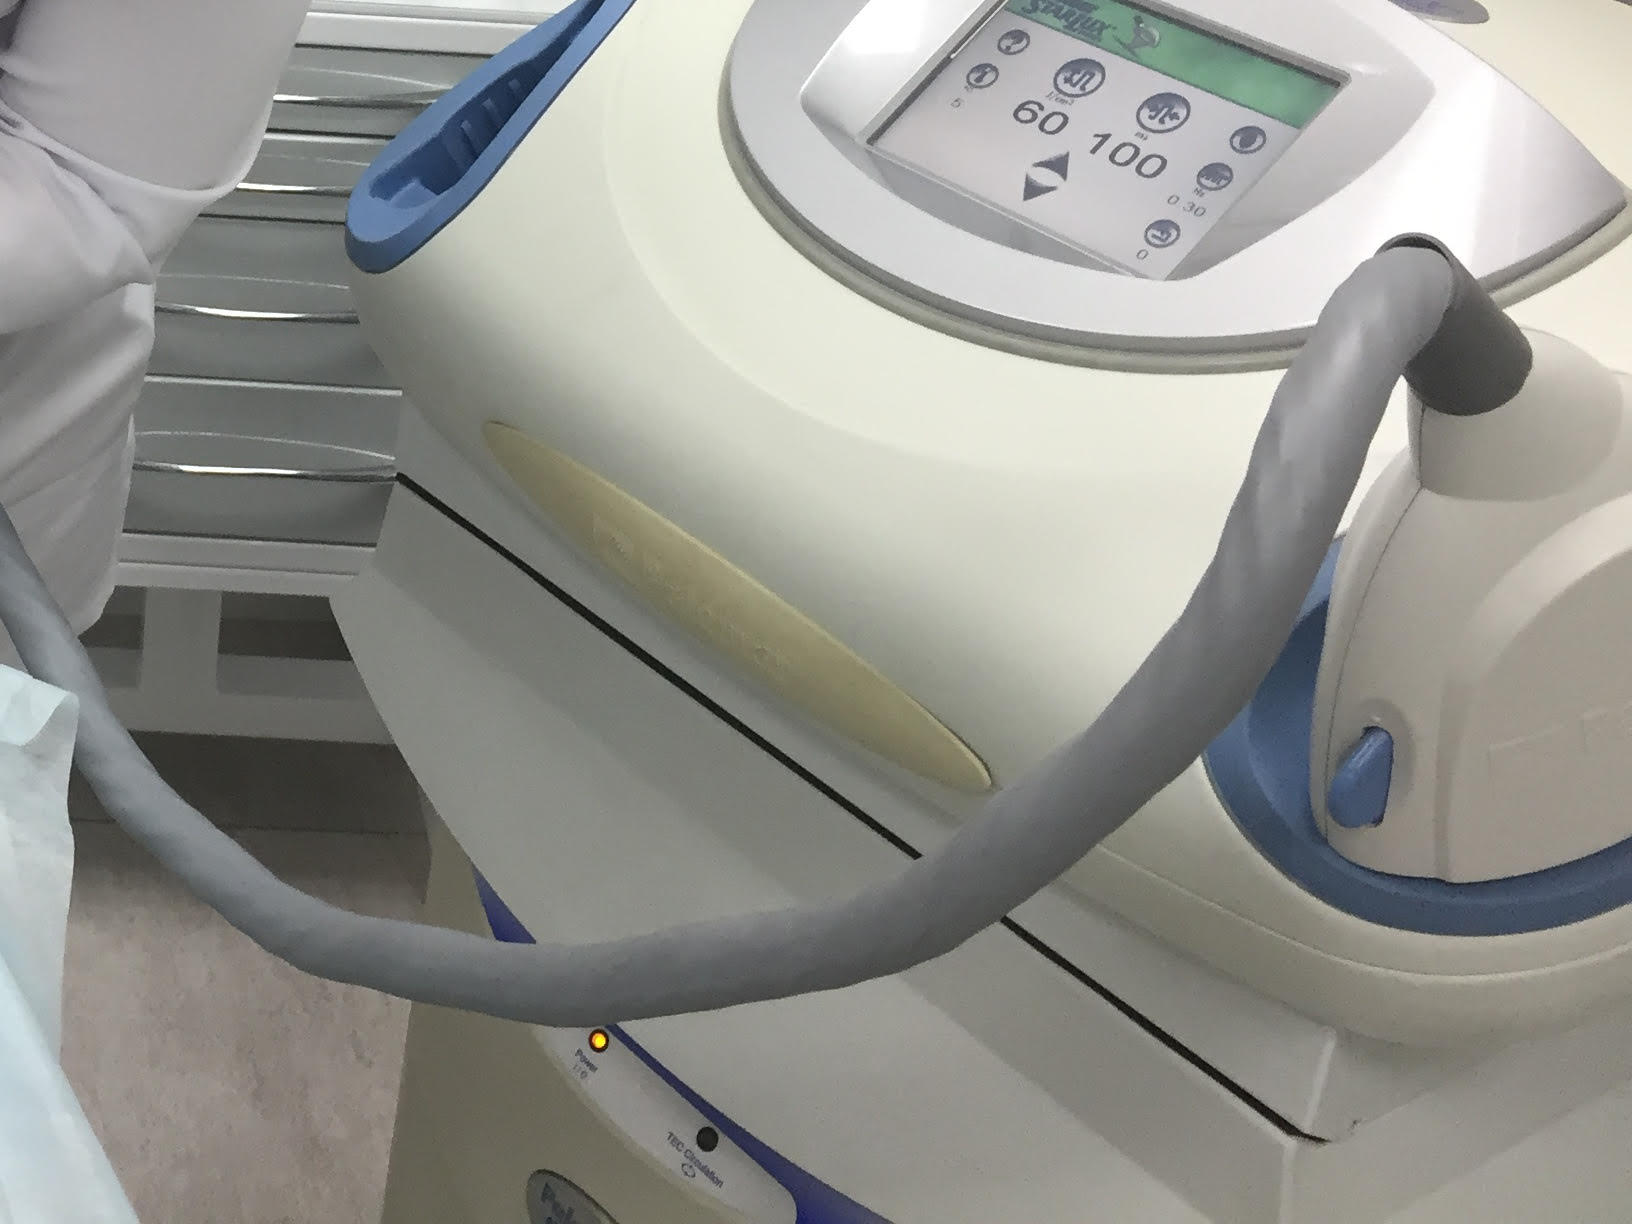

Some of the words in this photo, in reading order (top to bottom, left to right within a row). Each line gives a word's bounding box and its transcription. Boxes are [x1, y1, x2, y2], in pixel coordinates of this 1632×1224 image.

[1013, 100, 1069, 135] 60
[1089, 133, 1168, 179] 100
[575, 1048, 598, 1073] Power
[666, 1131, 685, 1153] TEC
[683, 1148, 724, 1189] Circulation
